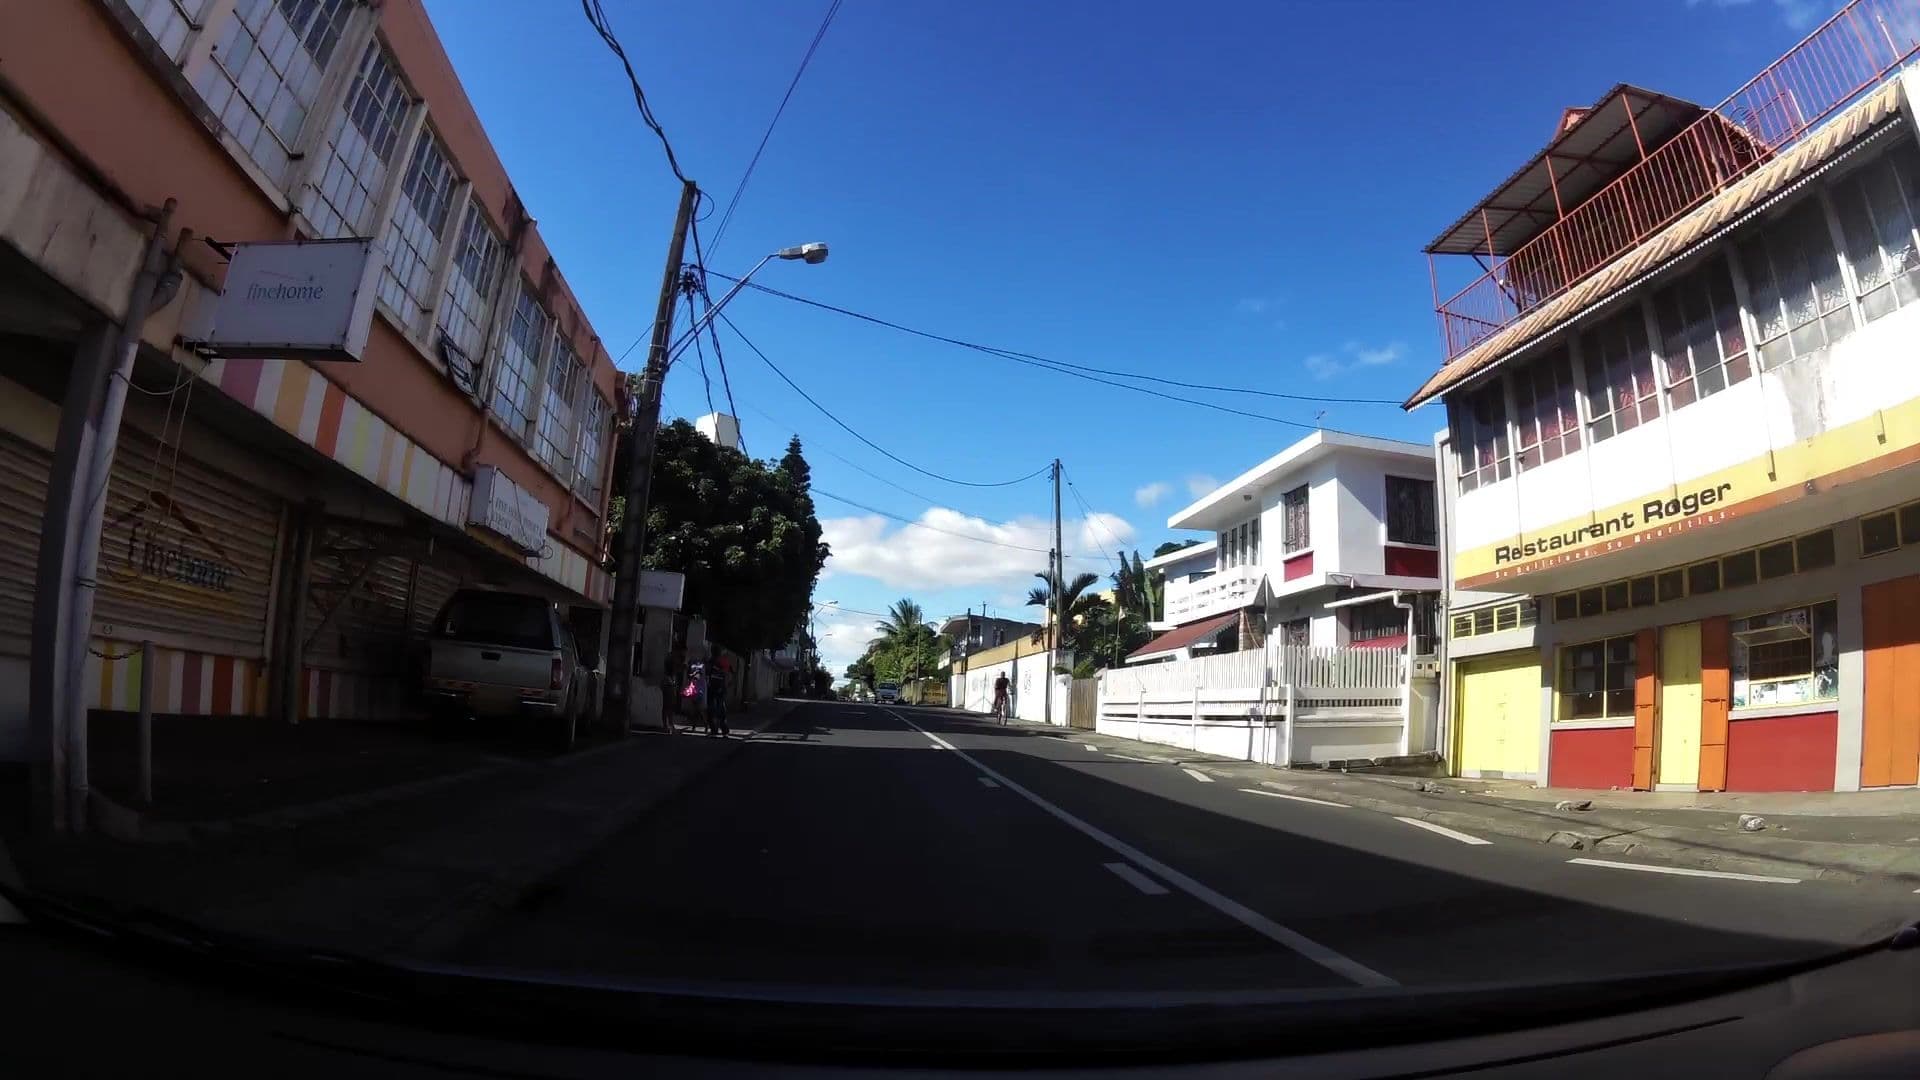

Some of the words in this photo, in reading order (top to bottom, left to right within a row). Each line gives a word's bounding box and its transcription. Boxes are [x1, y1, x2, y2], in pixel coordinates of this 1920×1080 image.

[247, 282, 323, 299] finehome
[1495, 511, 1634, 564] Restaurant
[1643, 483, 1731, 524] Roger
